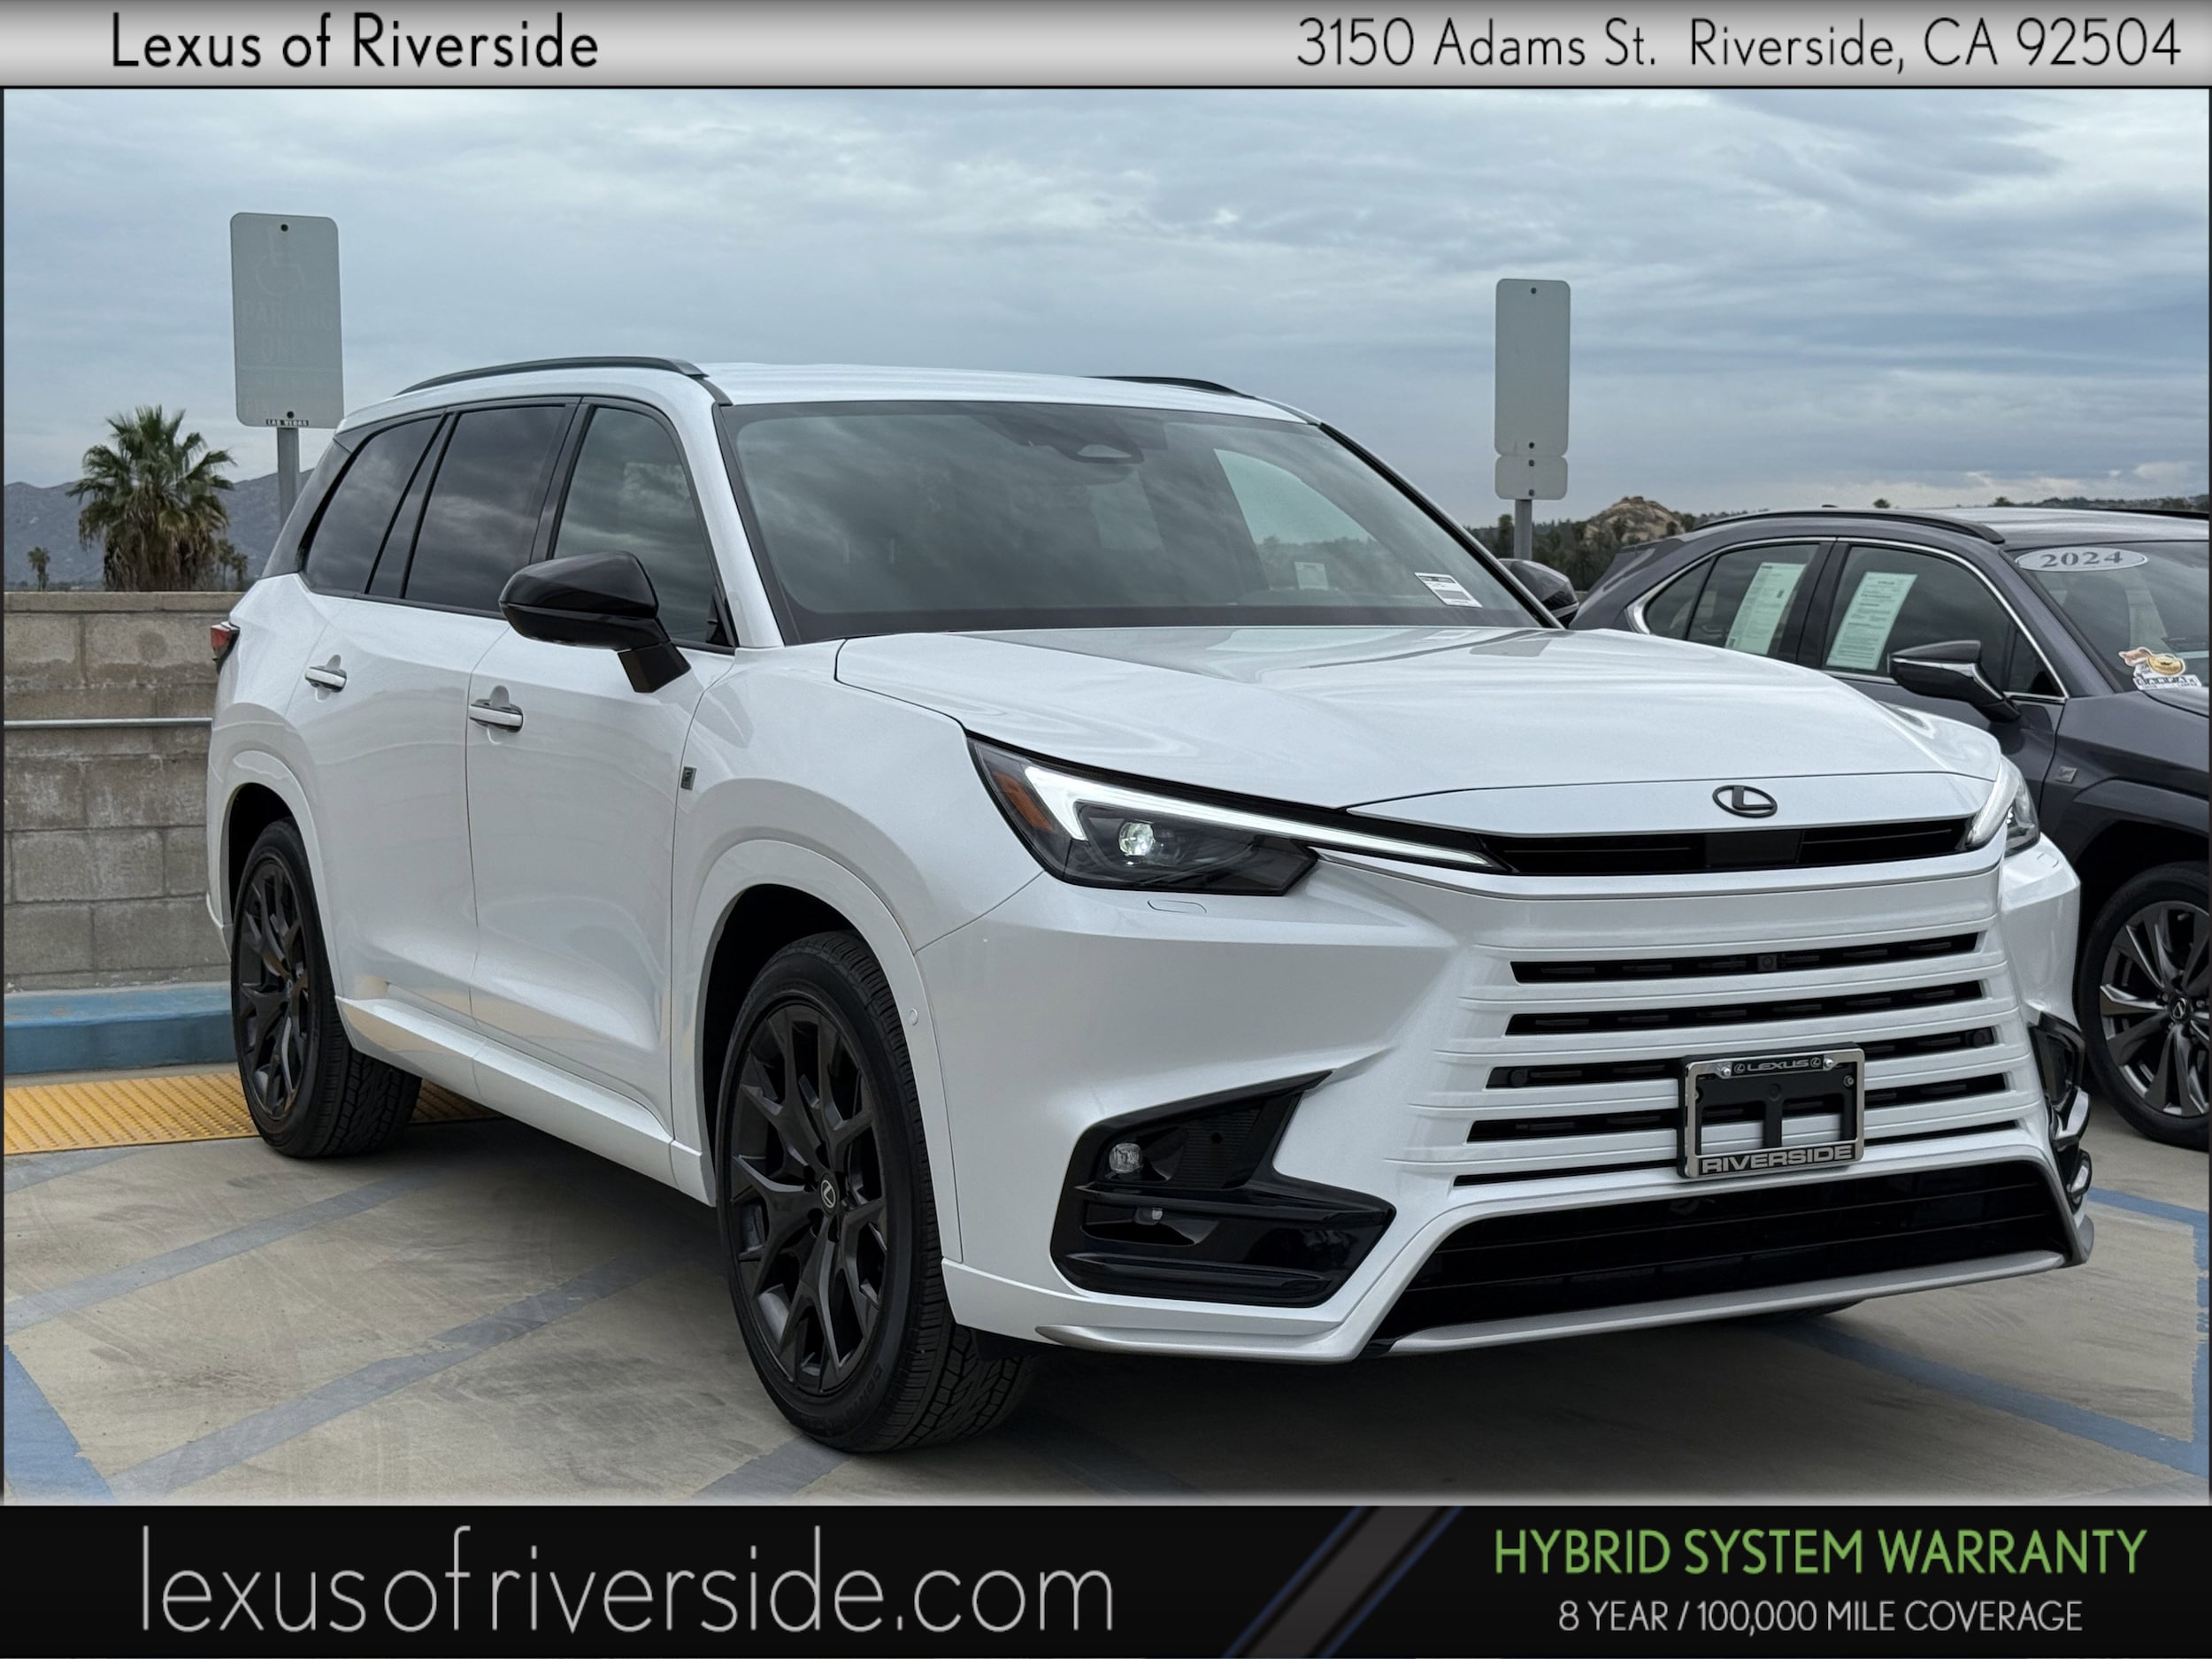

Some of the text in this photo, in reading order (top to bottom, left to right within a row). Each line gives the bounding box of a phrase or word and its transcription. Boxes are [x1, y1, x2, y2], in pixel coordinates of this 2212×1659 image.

[2041, 551, 2123, 568] 2024
[1746, 1058, 1810, 1072] LEXUS
[1701, 1145, 1854, 1174] RIVERSIDE
